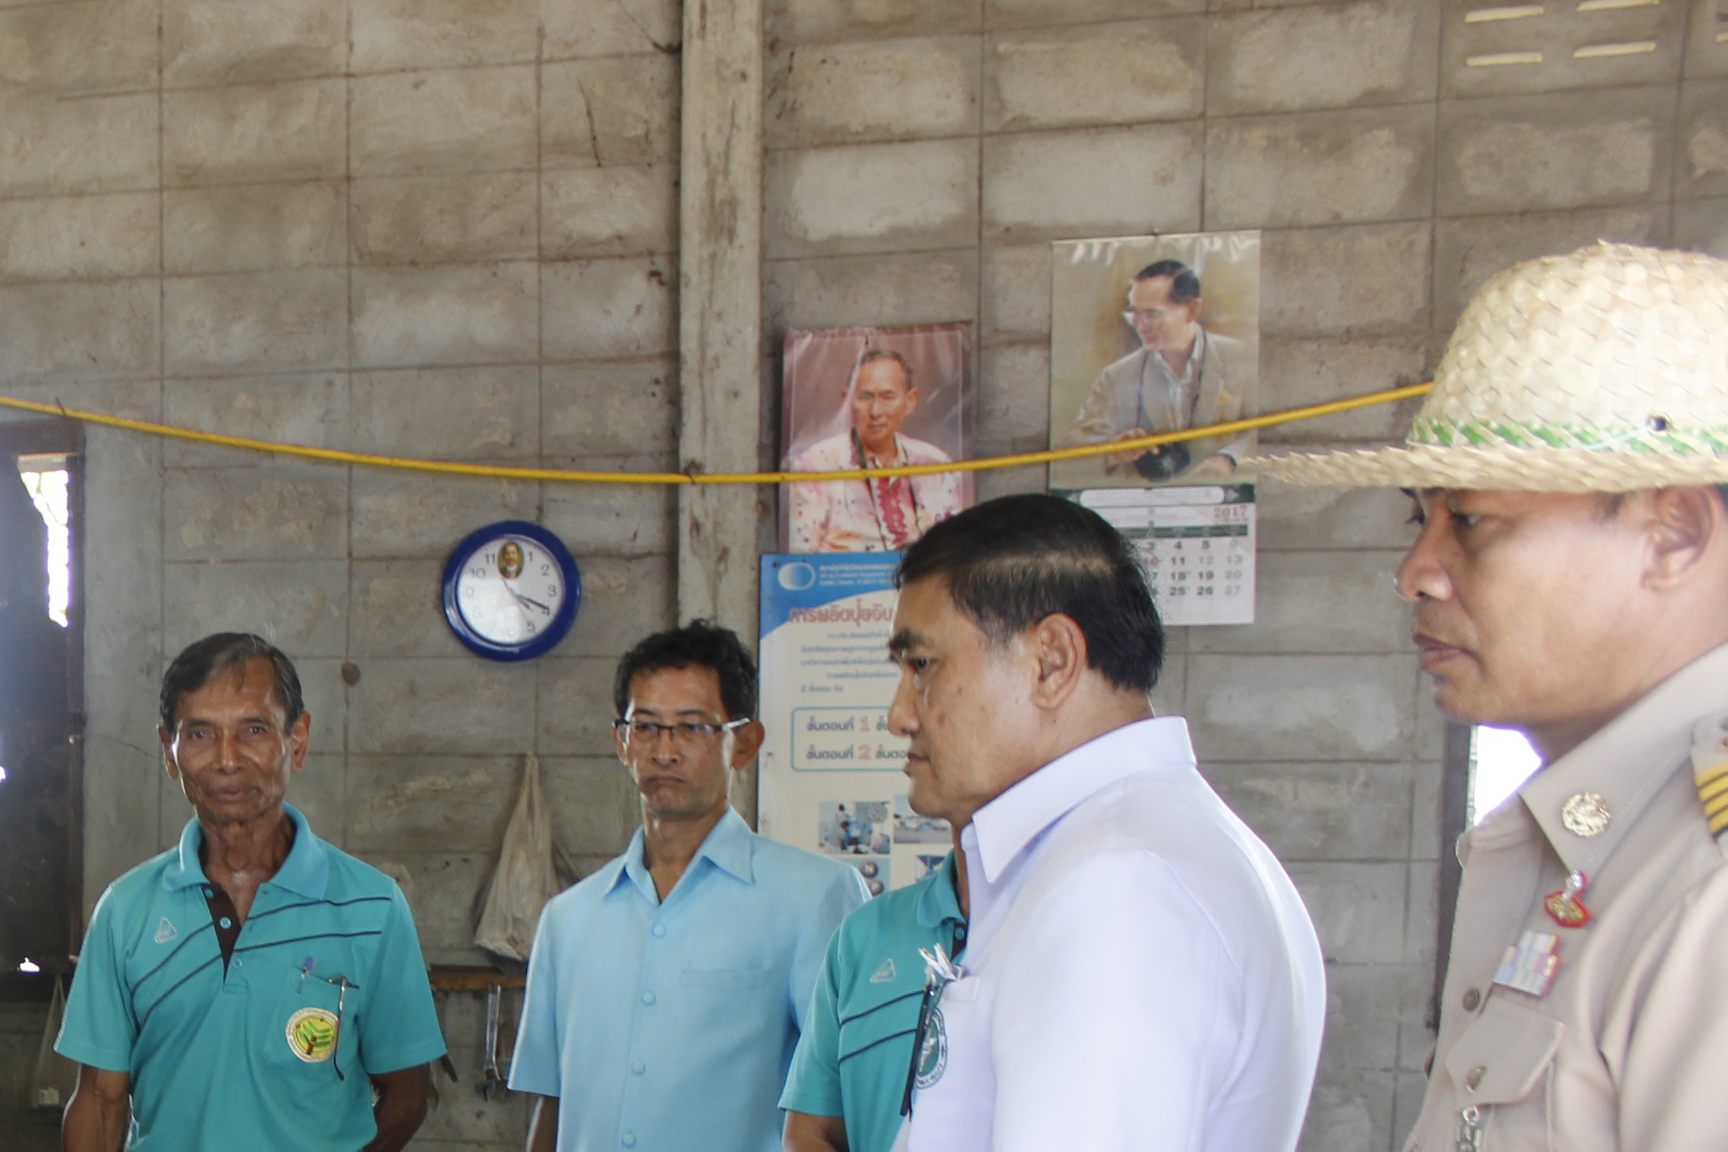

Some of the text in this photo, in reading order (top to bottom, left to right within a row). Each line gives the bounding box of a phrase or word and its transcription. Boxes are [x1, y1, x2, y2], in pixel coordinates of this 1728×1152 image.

[1214, 505, 1247, 518] 2017
[1174, 541, 1182, 550] 4
[1202, 540, 1210, 550] 5
[486, 553, 496, 564] 11
[1171, 556, 1185, 565] 11
[540, 563, 550, 577] 2
[547, 584, 557, 598] 3
[1197, 586, 1214, 596] 26
[859, 715, 870, 732] 1
[858, 743, 871, 760] 2
